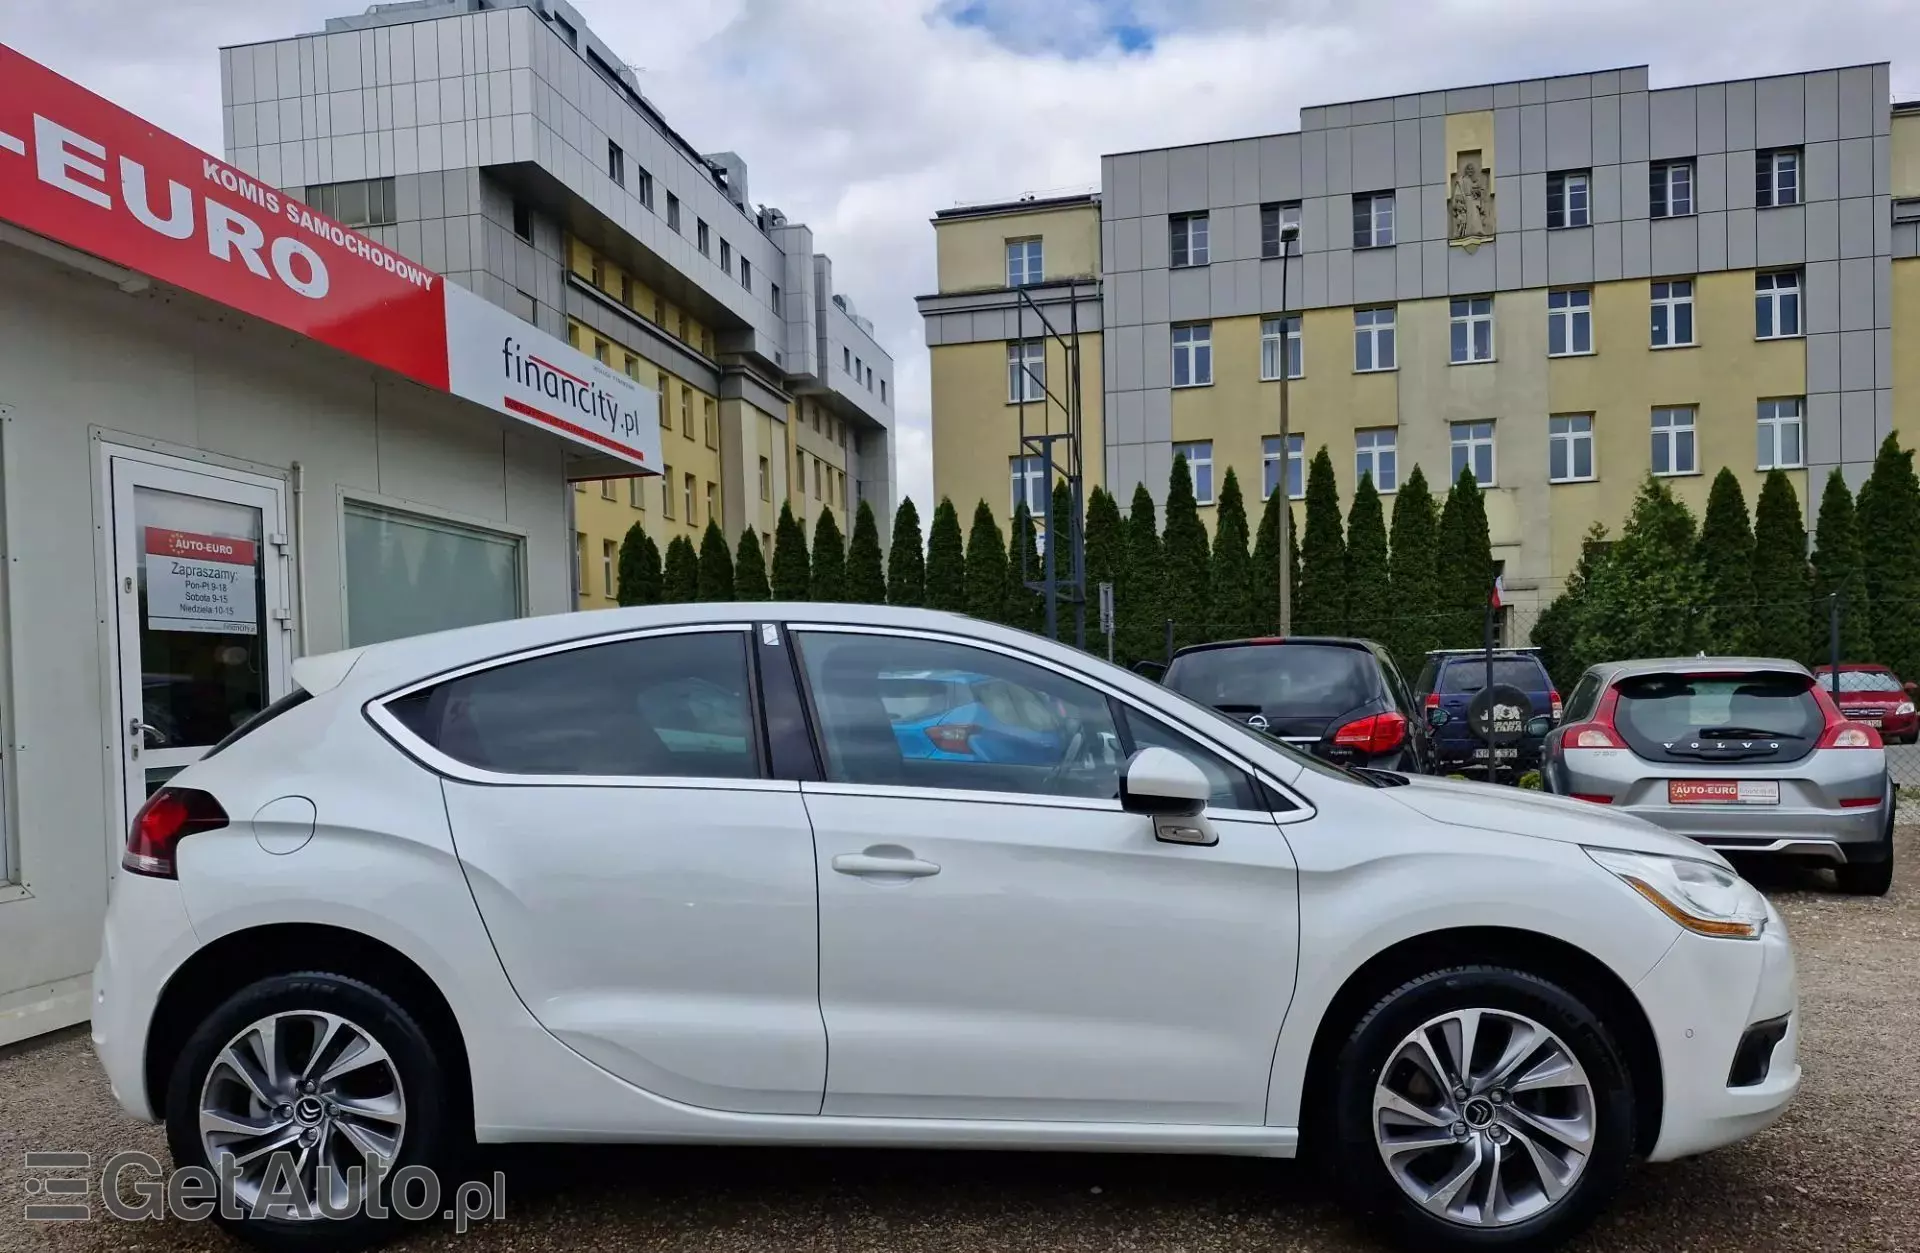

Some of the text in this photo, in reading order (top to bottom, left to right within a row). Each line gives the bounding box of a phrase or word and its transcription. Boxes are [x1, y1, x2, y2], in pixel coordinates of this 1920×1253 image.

[202, 158, 434, 292] KOMIS SAMOCHODOWY
[502, 336, 640, 438] financity.pl
[175, 539, 234, 555] AUTO-EURO
[171, 561, 239, 583] Zapraszamy:
[211, 582, 228, 592] 9-18
[185, 591, 229, 604] Sobota 9-15
[180, 603, 234, 615] Niedziela 10-15
[1481, 725, 1523, 733] VTARA
[1675, 785, 1737, 795] AUTO-EURO
